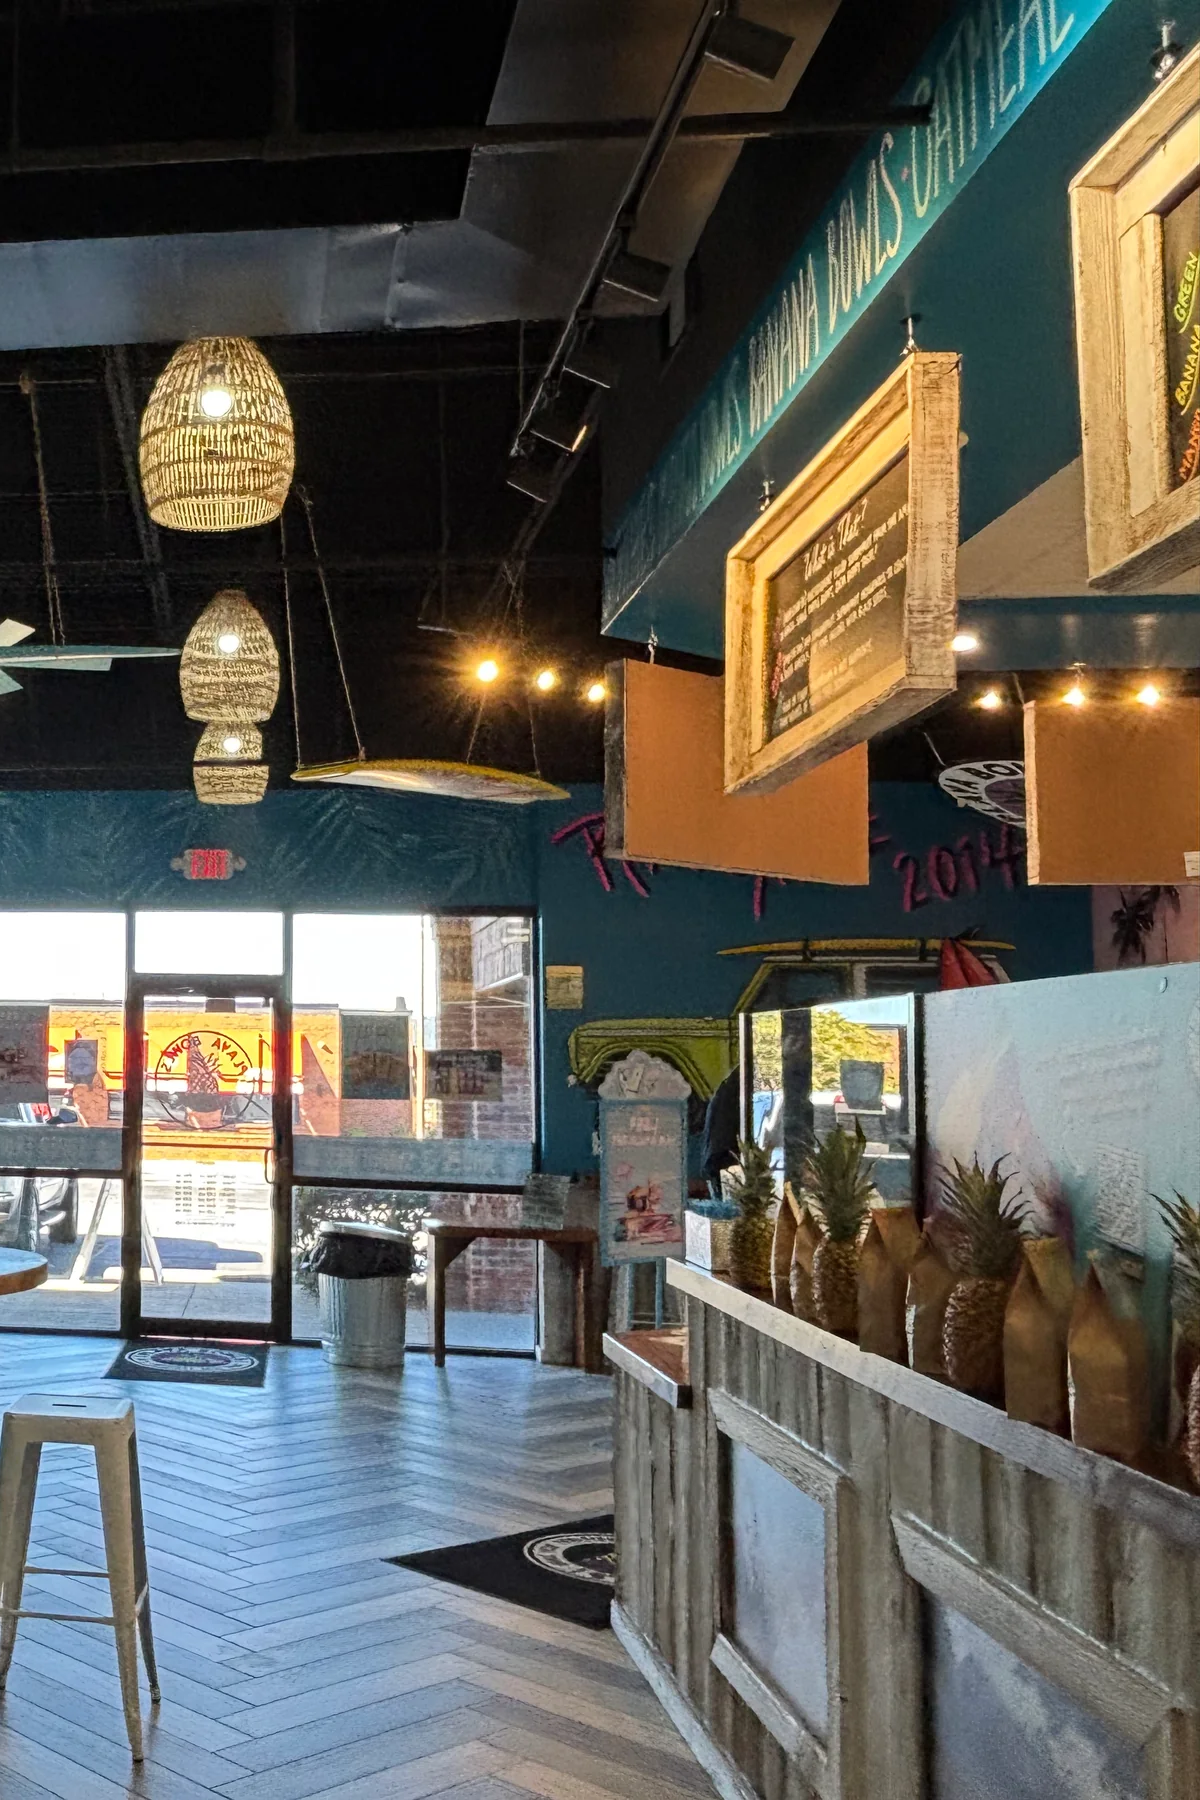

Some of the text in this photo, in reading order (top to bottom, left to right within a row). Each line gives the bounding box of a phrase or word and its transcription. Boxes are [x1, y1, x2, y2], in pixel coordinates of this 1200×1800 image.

[749, 253, 819, 438] BANANA
[826, 131, 902, 334] BOWLS
[1173, 251, 1199, 323] GREEN
[191, 850, 227, 879] EXIT
[893, 824, 1022, 913] 2014
